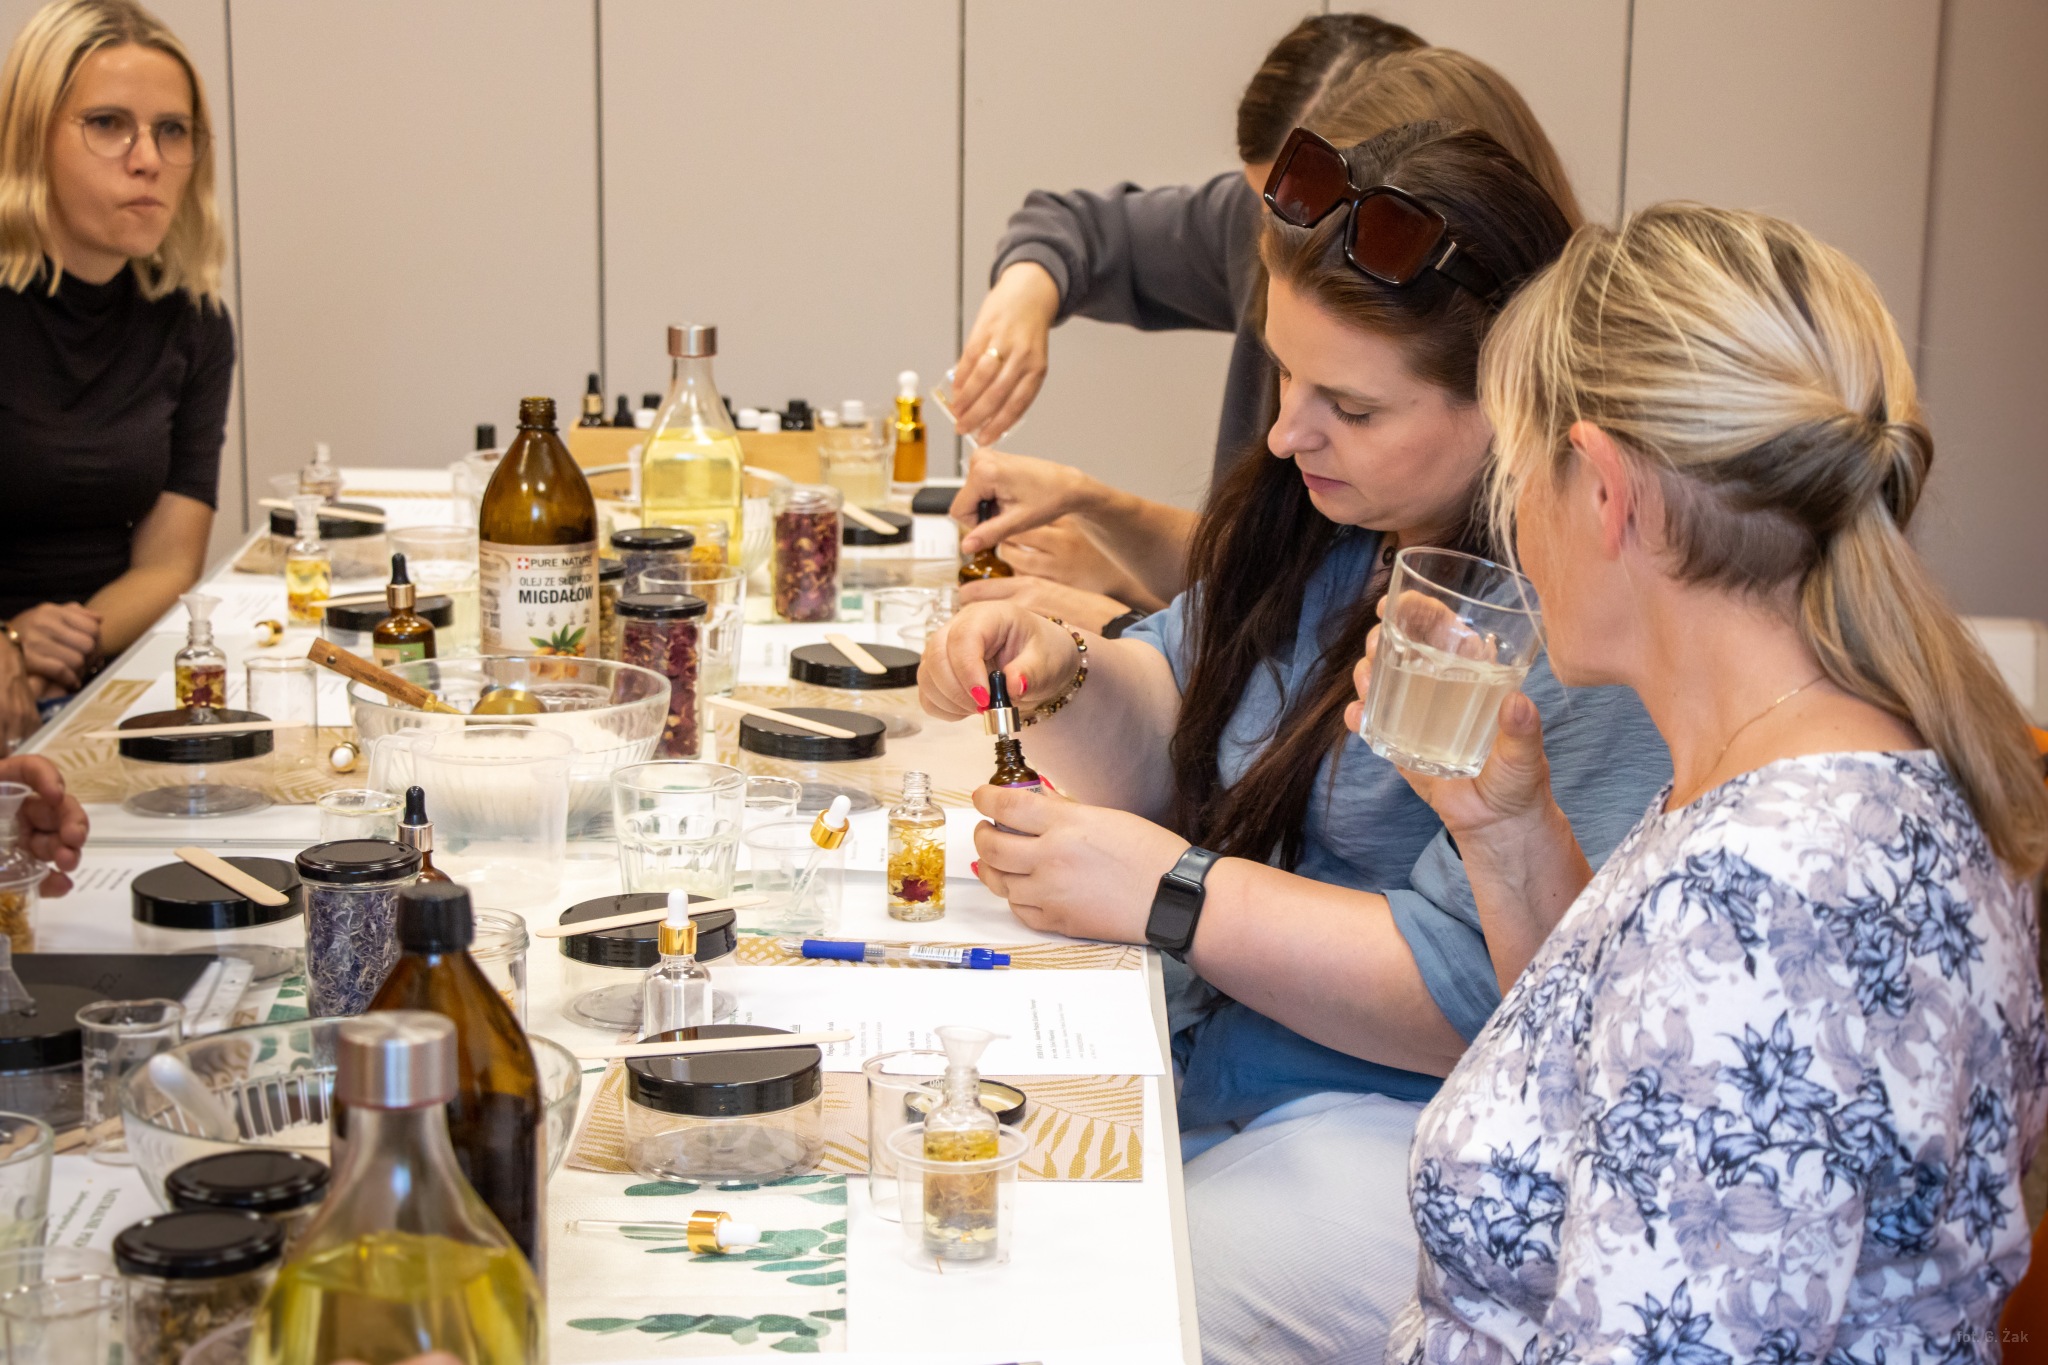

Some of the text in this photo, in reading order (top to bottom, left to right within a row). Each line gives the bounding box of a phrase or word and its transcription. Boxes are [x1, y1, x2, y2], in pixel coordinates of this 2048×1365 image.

[531, 554, 592, 568] PURE NATURE
[519, 576, 541, 587] OLEJ
[544, 577, 555, 587] ZE
[519, 584, 594, 604] MIGDAŁÓW
